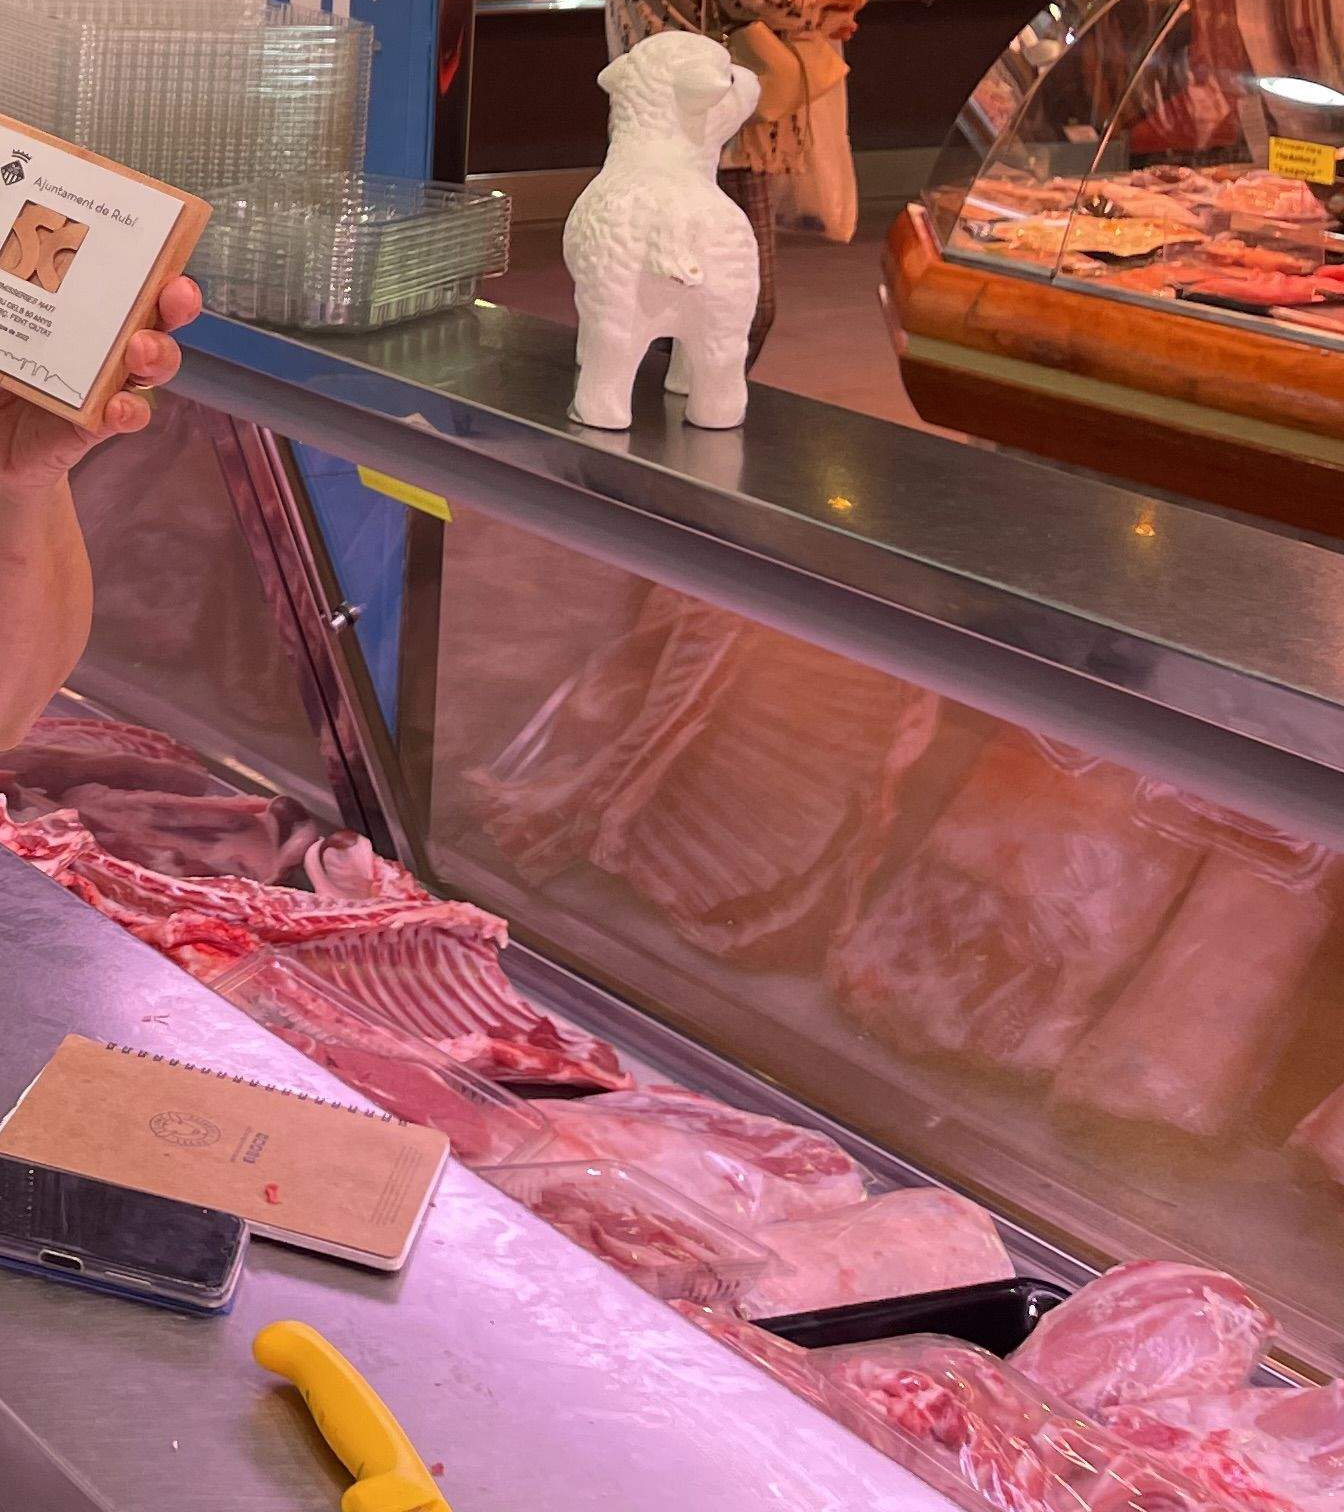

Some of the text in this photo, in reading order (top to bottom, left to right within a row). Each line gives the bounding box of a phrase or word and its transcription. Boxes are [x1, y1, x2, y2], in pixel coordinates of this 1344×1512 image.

[33, 175, 138, 228] Ajuntament de Rubí
